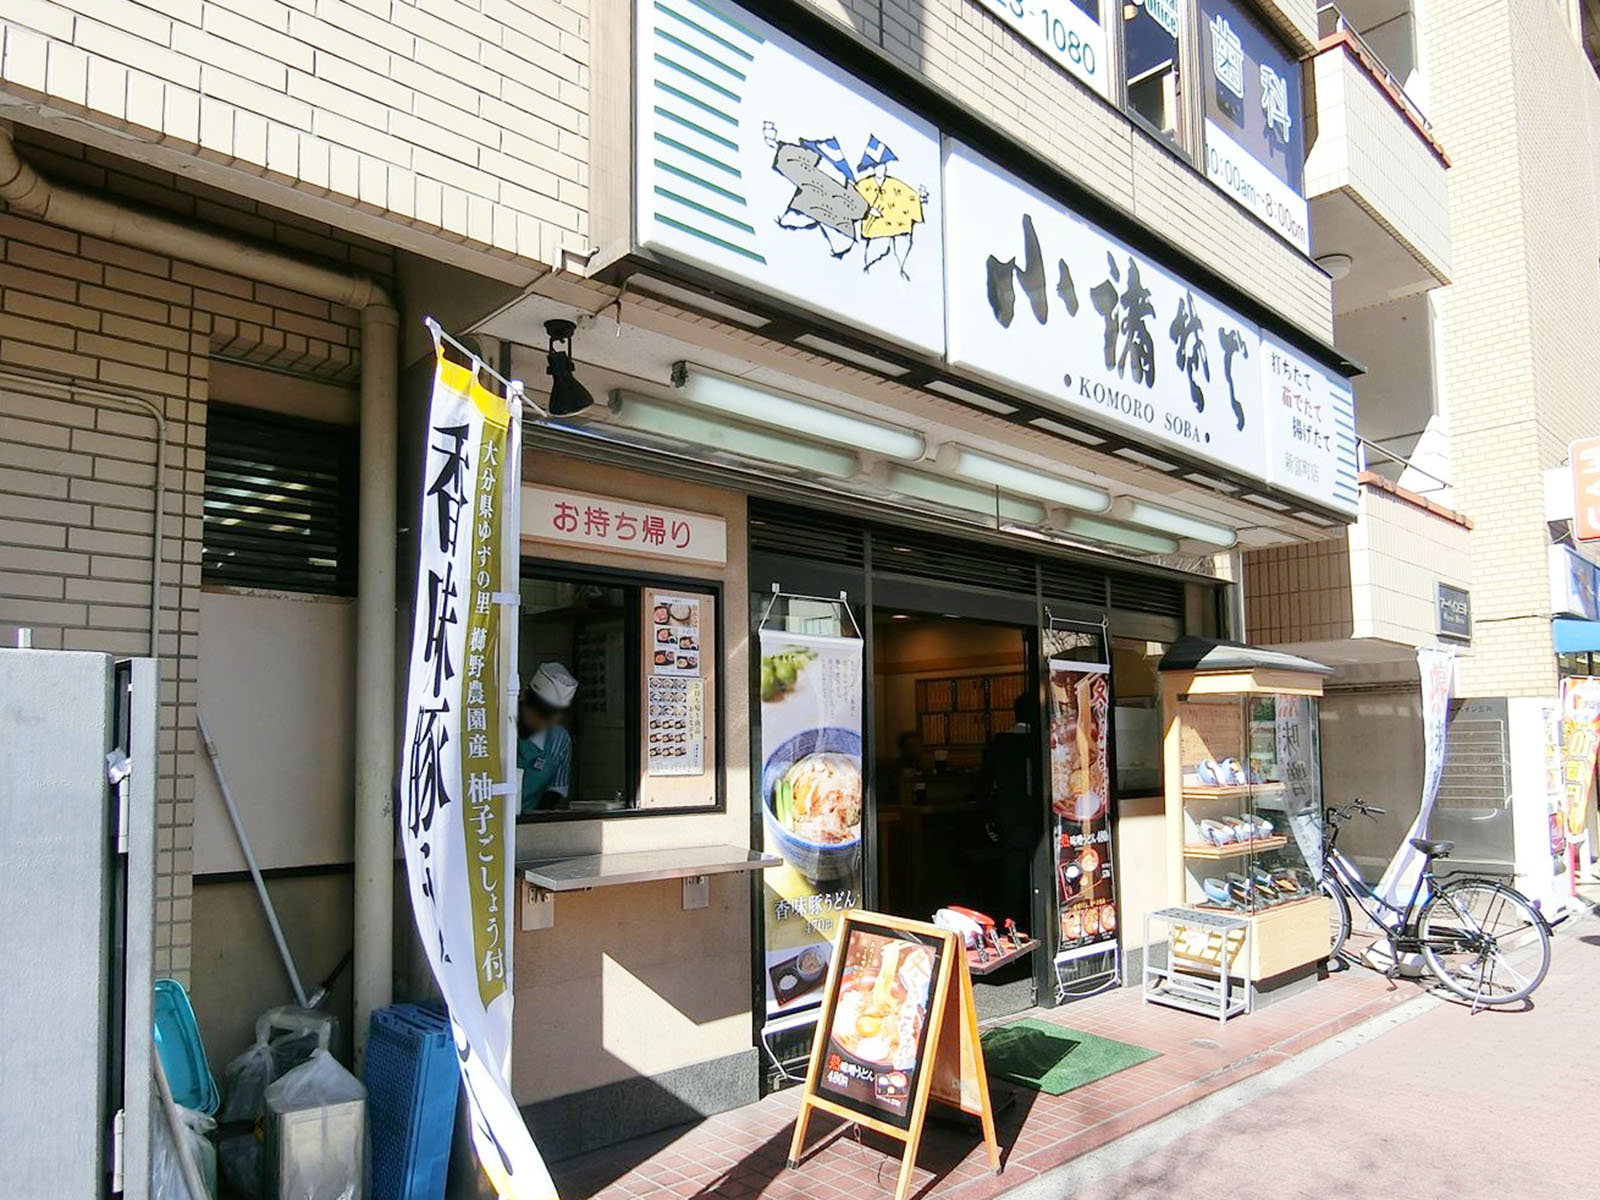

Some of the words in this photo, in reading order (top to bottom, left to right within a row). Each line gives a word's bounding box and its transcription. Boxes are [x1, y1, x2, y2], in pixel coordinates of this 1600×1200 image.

[999, 0, 1095, 75] 3-1080
[1210, 15, 1292, 142] 歯科
[1271, 351, 1312, 392] 打ちたて
[1078, 375, 1155, 425] KOMORO
[1164, 412, 1201, 443] SOBA
[1292, 416, 1331, 452] 揚げたて
[475, 438, 499, 615] 大分県ゆずの里
[553, 501, 692, 549] お持ち帰り
[467, 771, 504, 982] 柚子ごしょう付
[774, 890, 857, 921] 香味豚うどん
